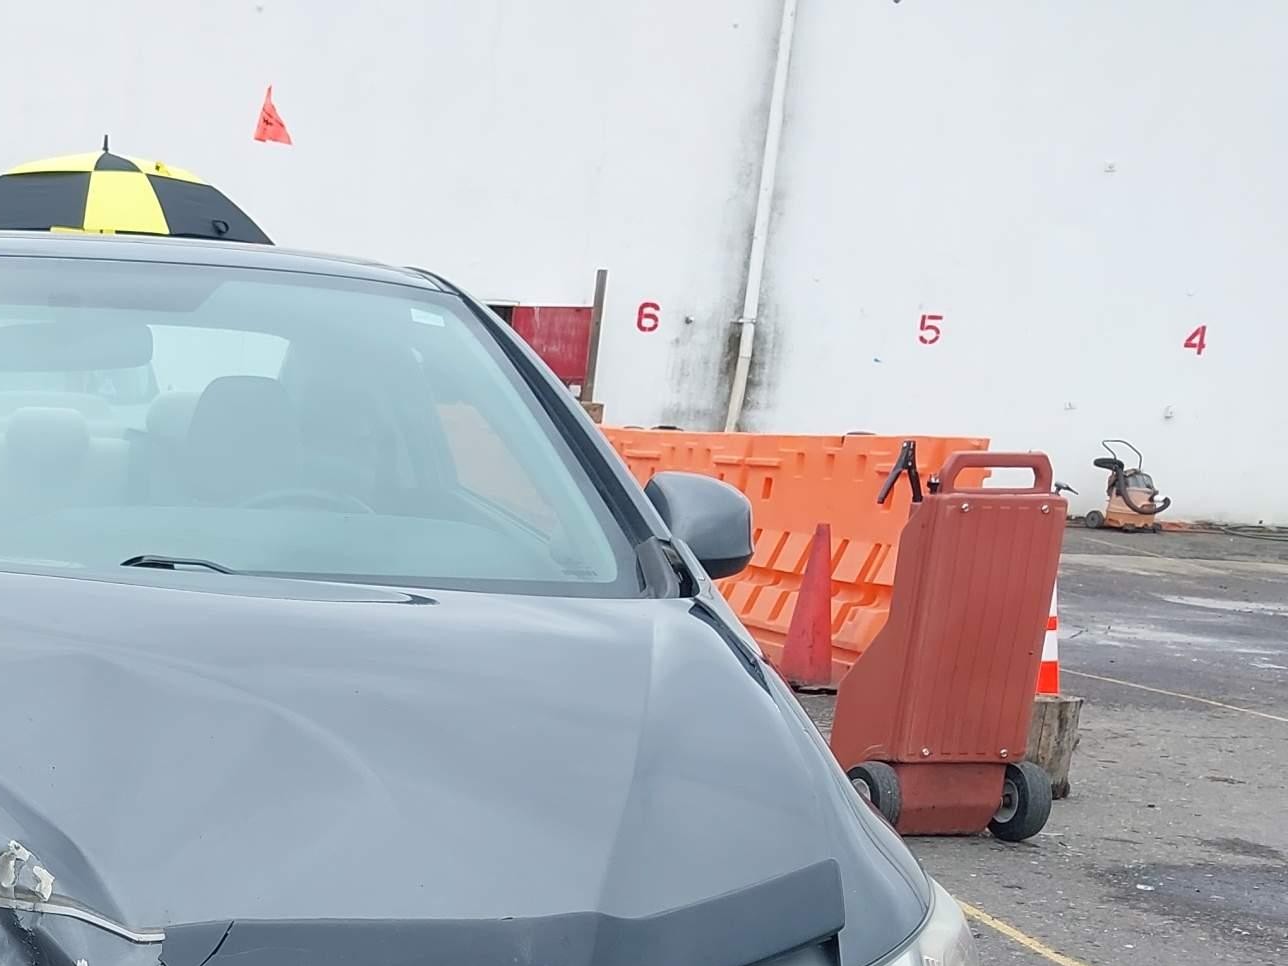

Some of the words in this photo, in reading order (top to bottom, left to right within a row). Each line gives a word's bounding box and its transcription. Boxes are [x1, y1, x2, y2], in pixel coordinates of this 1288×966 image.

[636, 300, 660, 333] 6
[919, 314, 943, 345] 5
[1183, 325, 1207, 355] 4
